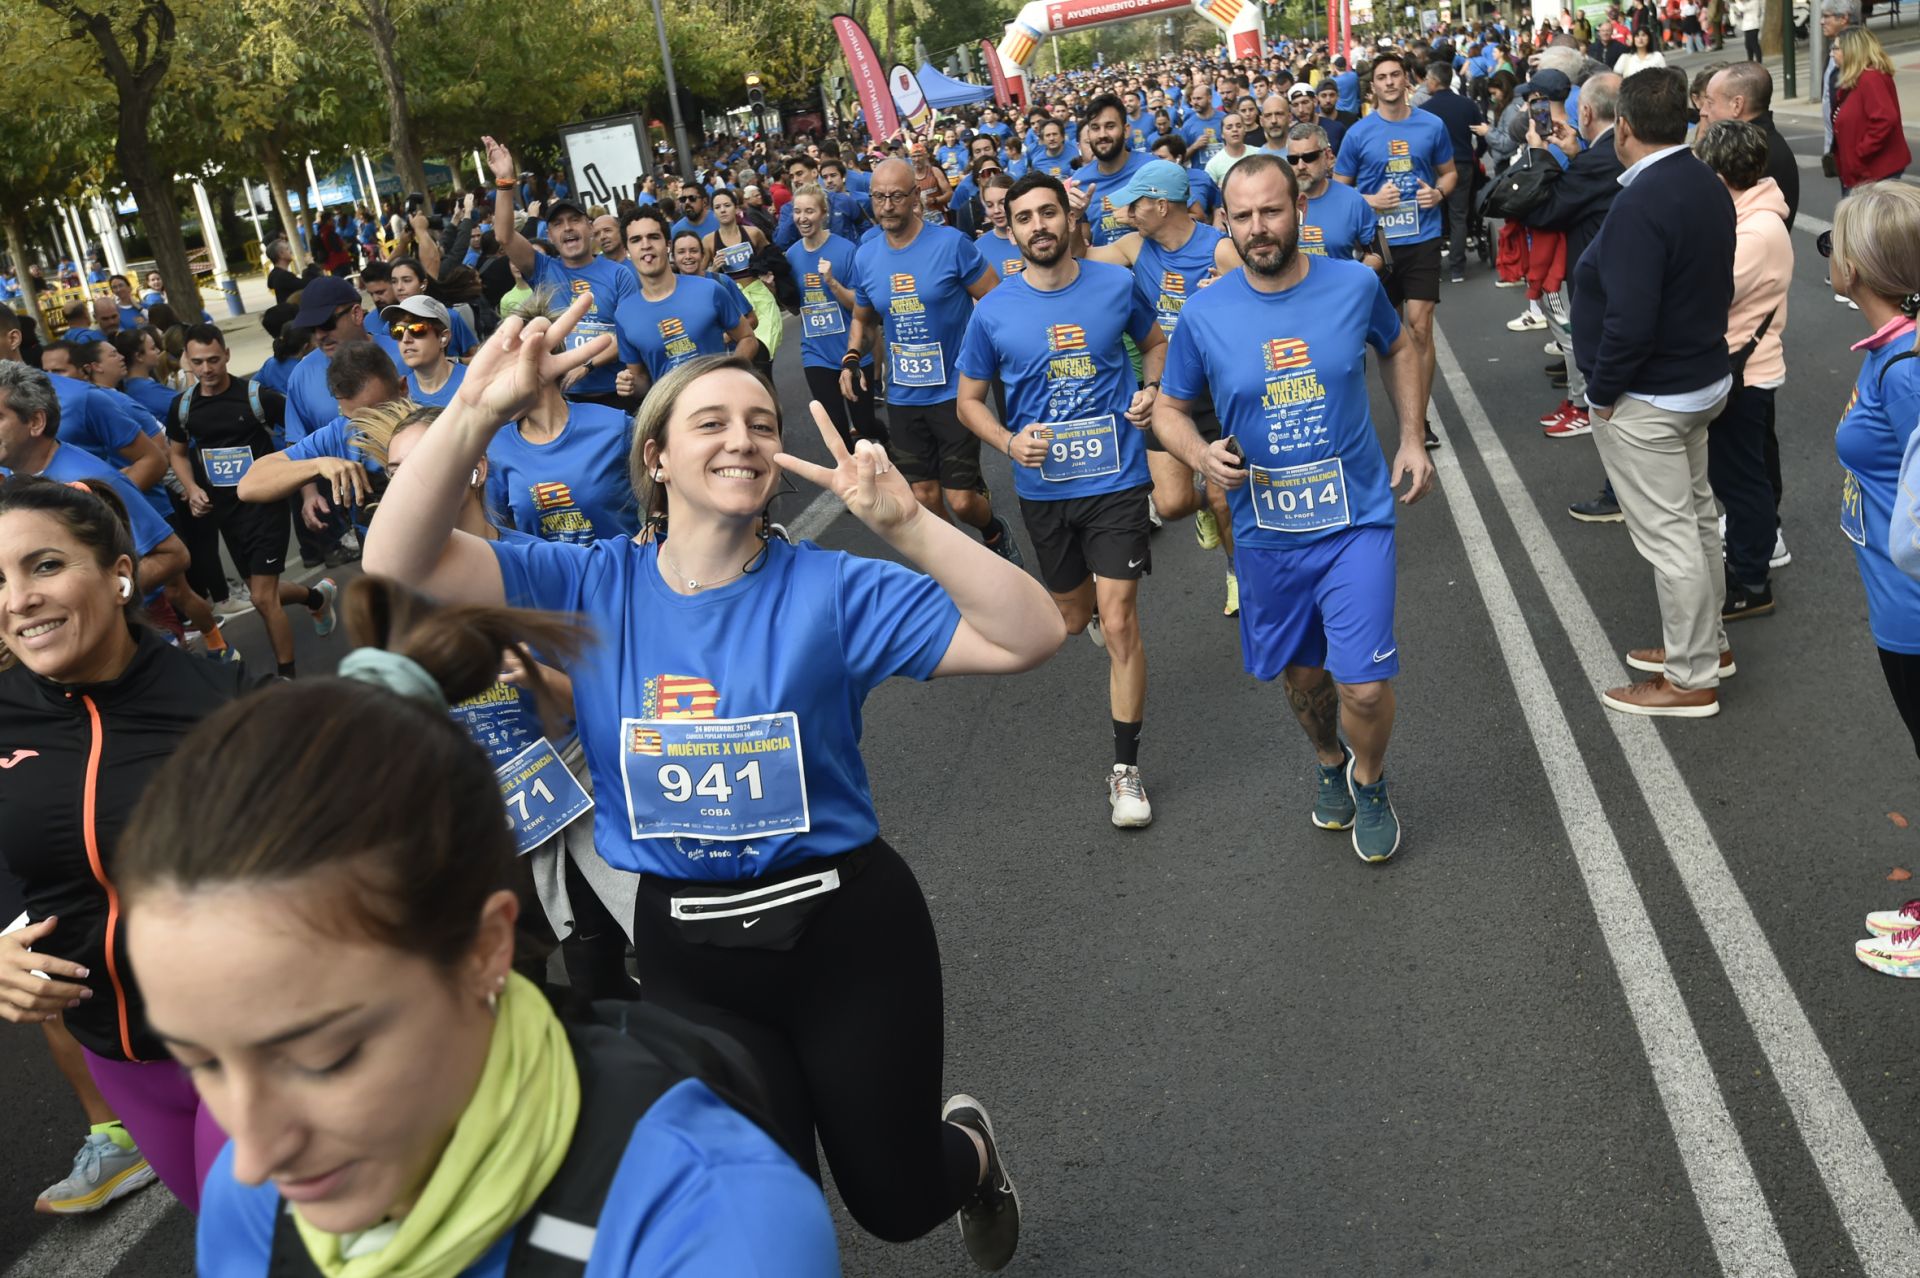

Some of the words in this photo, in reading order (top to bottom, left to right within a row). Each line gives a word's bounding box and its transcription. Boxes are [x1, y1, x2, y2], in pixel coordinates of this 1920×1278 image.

[1066, 1, 1136, 20] AYUNTAMIENTO
[810, 313, 833, 326] 691
[900, 358, 932, 373] 833
[1262, 395, 1270, 407] X
[1272, 384, 1326, 405] VALENCIA
[1052, 438, 1103, 463] 959
[213, 460, 243, 475] 527
[1261, 482, 1338, 512] 1014
[667, 741, 720, 756] MUÉVETE
[724, 743, 732, 755] X
[734, 737, 791, 754] VALENCIA
[520, 753, 554, 781] VALENCIA
[657, 760, 764, 803] 941
[506, 777, 555, 831] 71
[700, 808, 731, 816] COBA
[522, 815, 545, 832] FERRE
